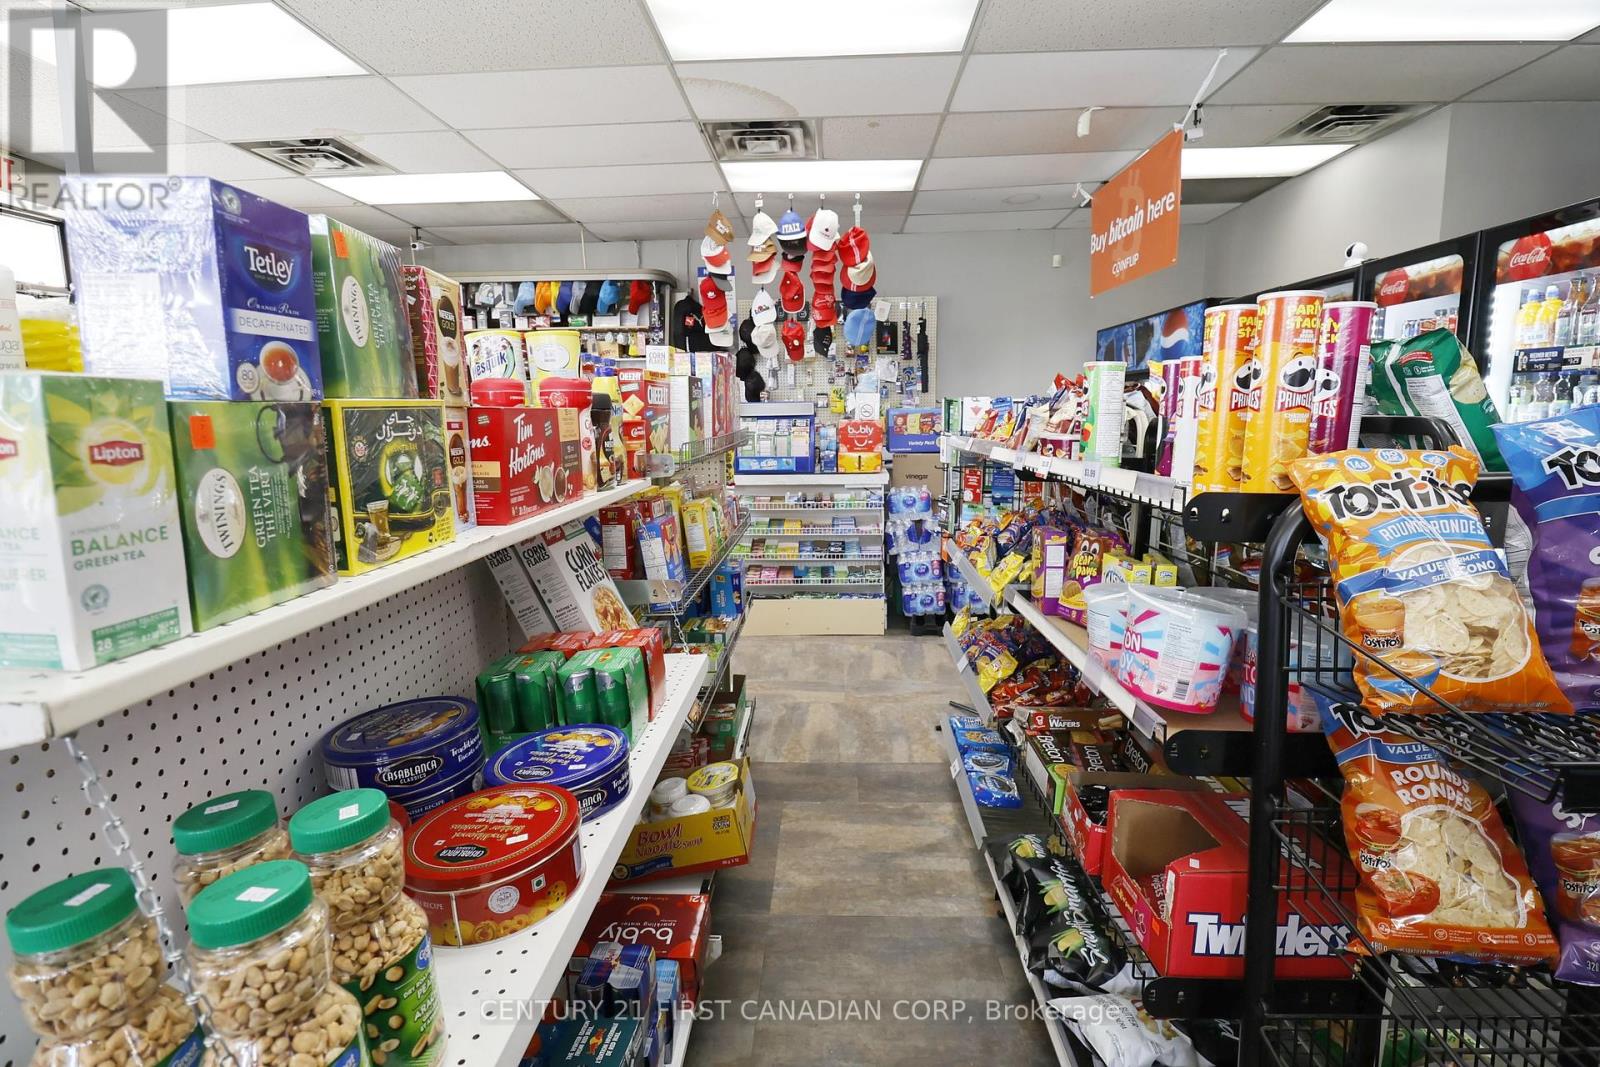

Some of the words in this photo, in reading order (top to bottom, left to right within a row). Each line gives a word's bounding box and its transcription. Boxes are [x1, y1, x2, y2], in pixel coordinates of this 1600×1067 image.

[1090, 234, 1107, 255] Buy
[1108, 208, 1145, 246] bitcoin
[1147, 191, 1175, 224] here
[244, 246, 294, 285] Tetley
[1112, 252, 1139, 276] COINFLIP
[1510, 247, 1549, 267] Coca-Cola
[1380, 280, 1408, 296] Coca-Cola
[239, 316, 309, 336] DECAFFEINATED
[514, 413, 534, 444] Tim
[94, 445, 140, 462] Lipton
[509, 443, 545, 478] Hortons
[248, 465, 260, 494] TEA
[260, 469, 273, 508] VERT
[213, 473, 234, 551] TWININGS
[251, 498, 267, 549] GREEN
[1432, 519, 1486, 535] RONDES
[71, 526, 169, 556] BALANCE
[522, 543, 546, 560] CORN
[74, 555, 120, 571] GREEN
[123, 550, 146, 561] TEA
[490, 554, 512, 568] FLAKES
[528, 553, 550, 568] FLAKES
[565, 542, 597, 573] CORN
[576, 563, 605, 592] FLAKES
[1396, 560, 1444, 581] VALUE
[97, 638, 112, 650] 28
[1124, 737, 1149, 775] Breton
[1387, 744, 1429, 755] VALUE
[382, 760, 437, 782] CASABLANCA
[400, 773, 427, 784] CLASSICS
[1390, 764, 1470, 793] ROUNDS
[579, 792, 602, 808] LANCA
[1396, 781, 1473, 812] RONDES
[440, 849, 485, 858] CASABLANCA
